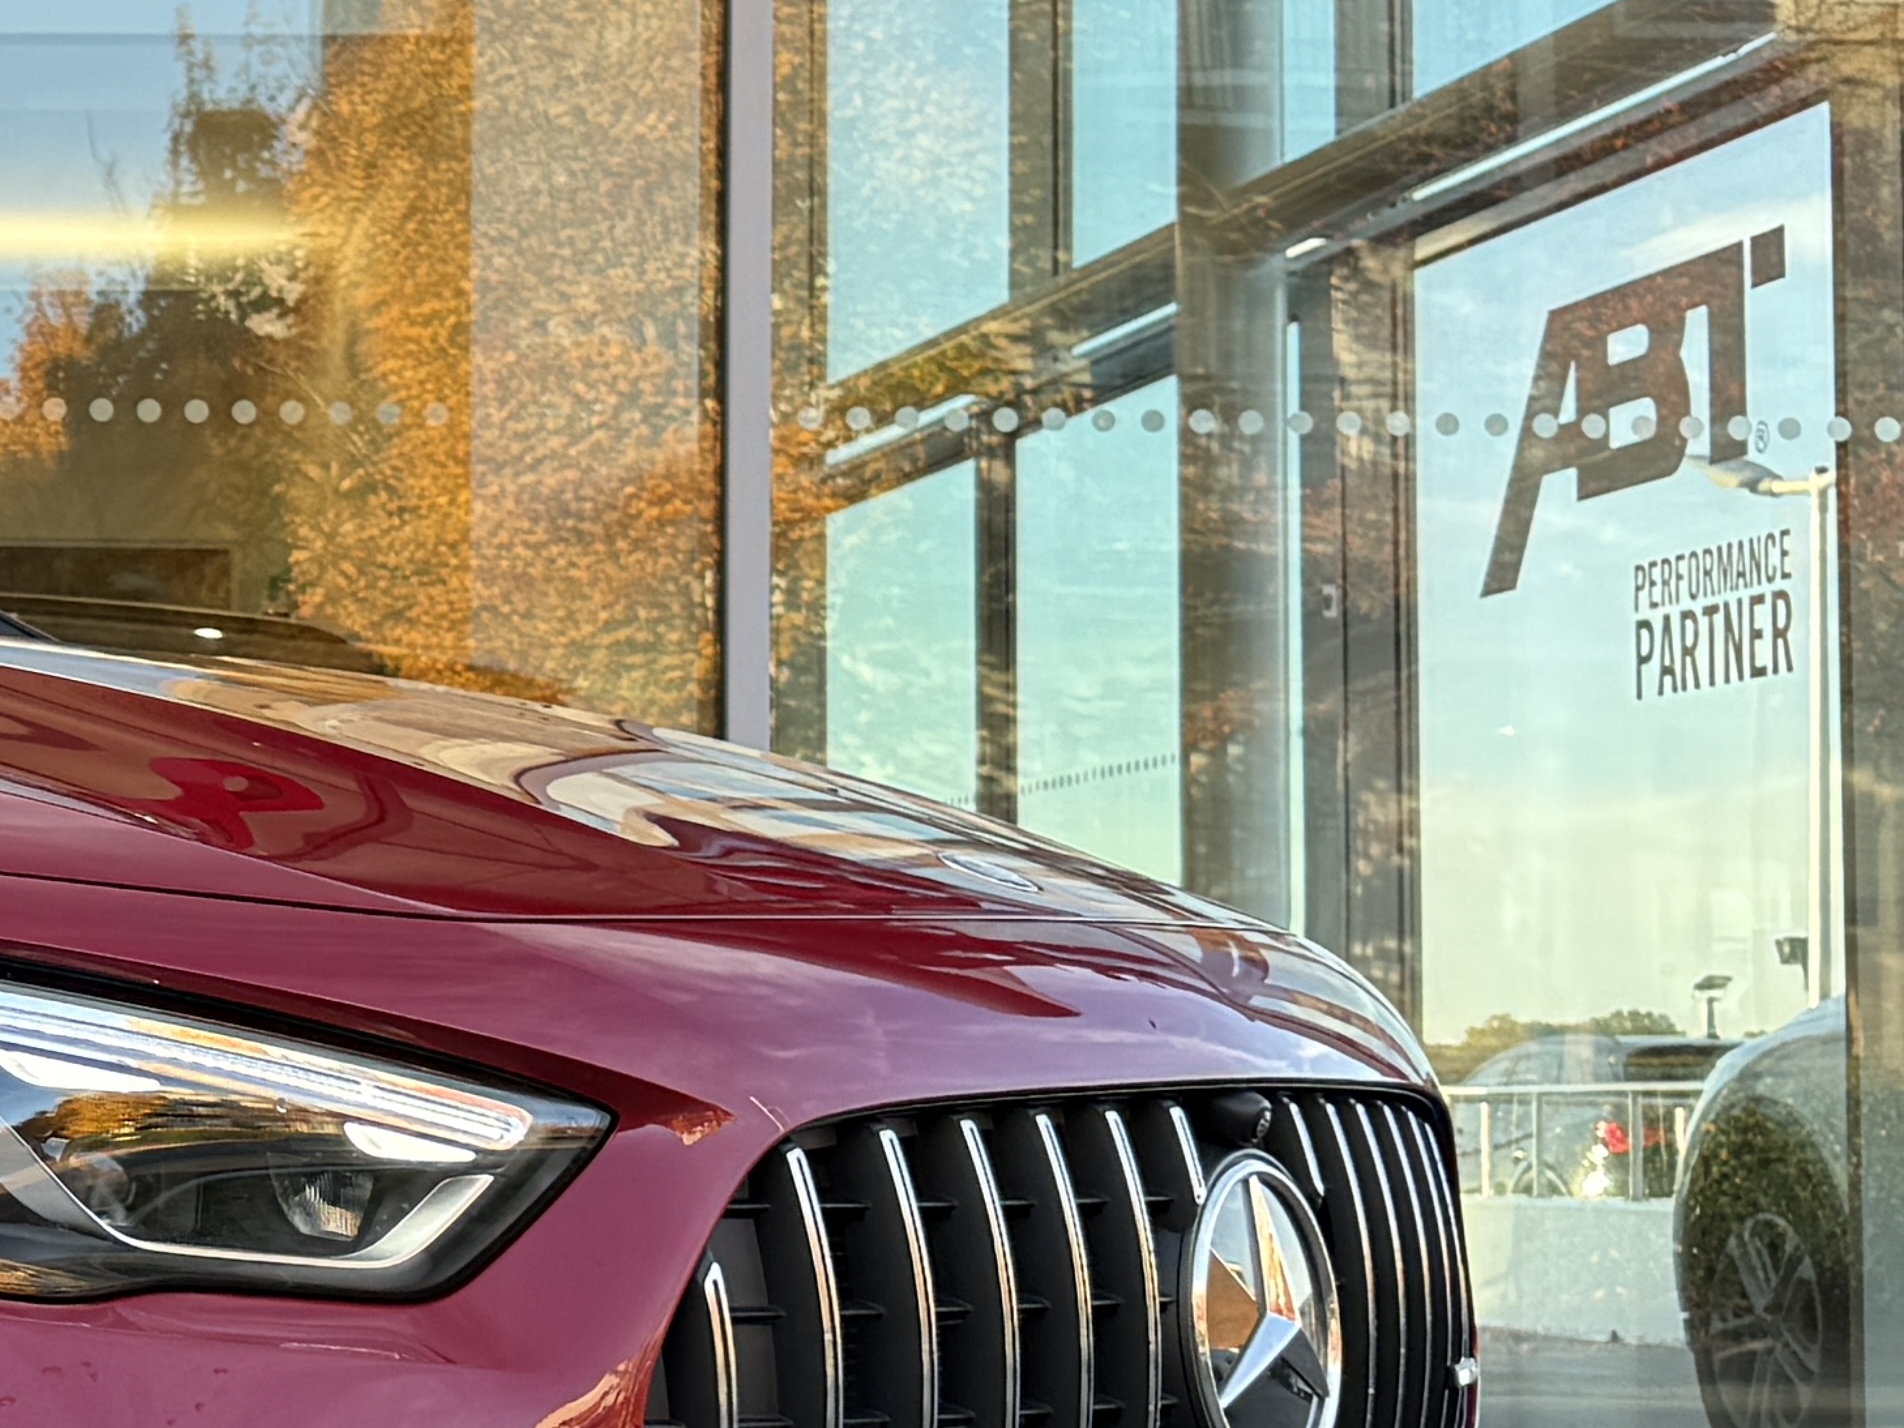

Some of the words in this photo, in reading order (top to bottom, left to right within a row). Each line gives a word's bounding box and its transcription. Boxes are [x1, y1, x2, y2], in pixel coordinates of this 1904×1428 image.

[1480, 223, 1786, 599] ABT
[1633, 528, 1793, 614] PERFORMANCE
[1635, 589, 1794, 701] PARTNER
